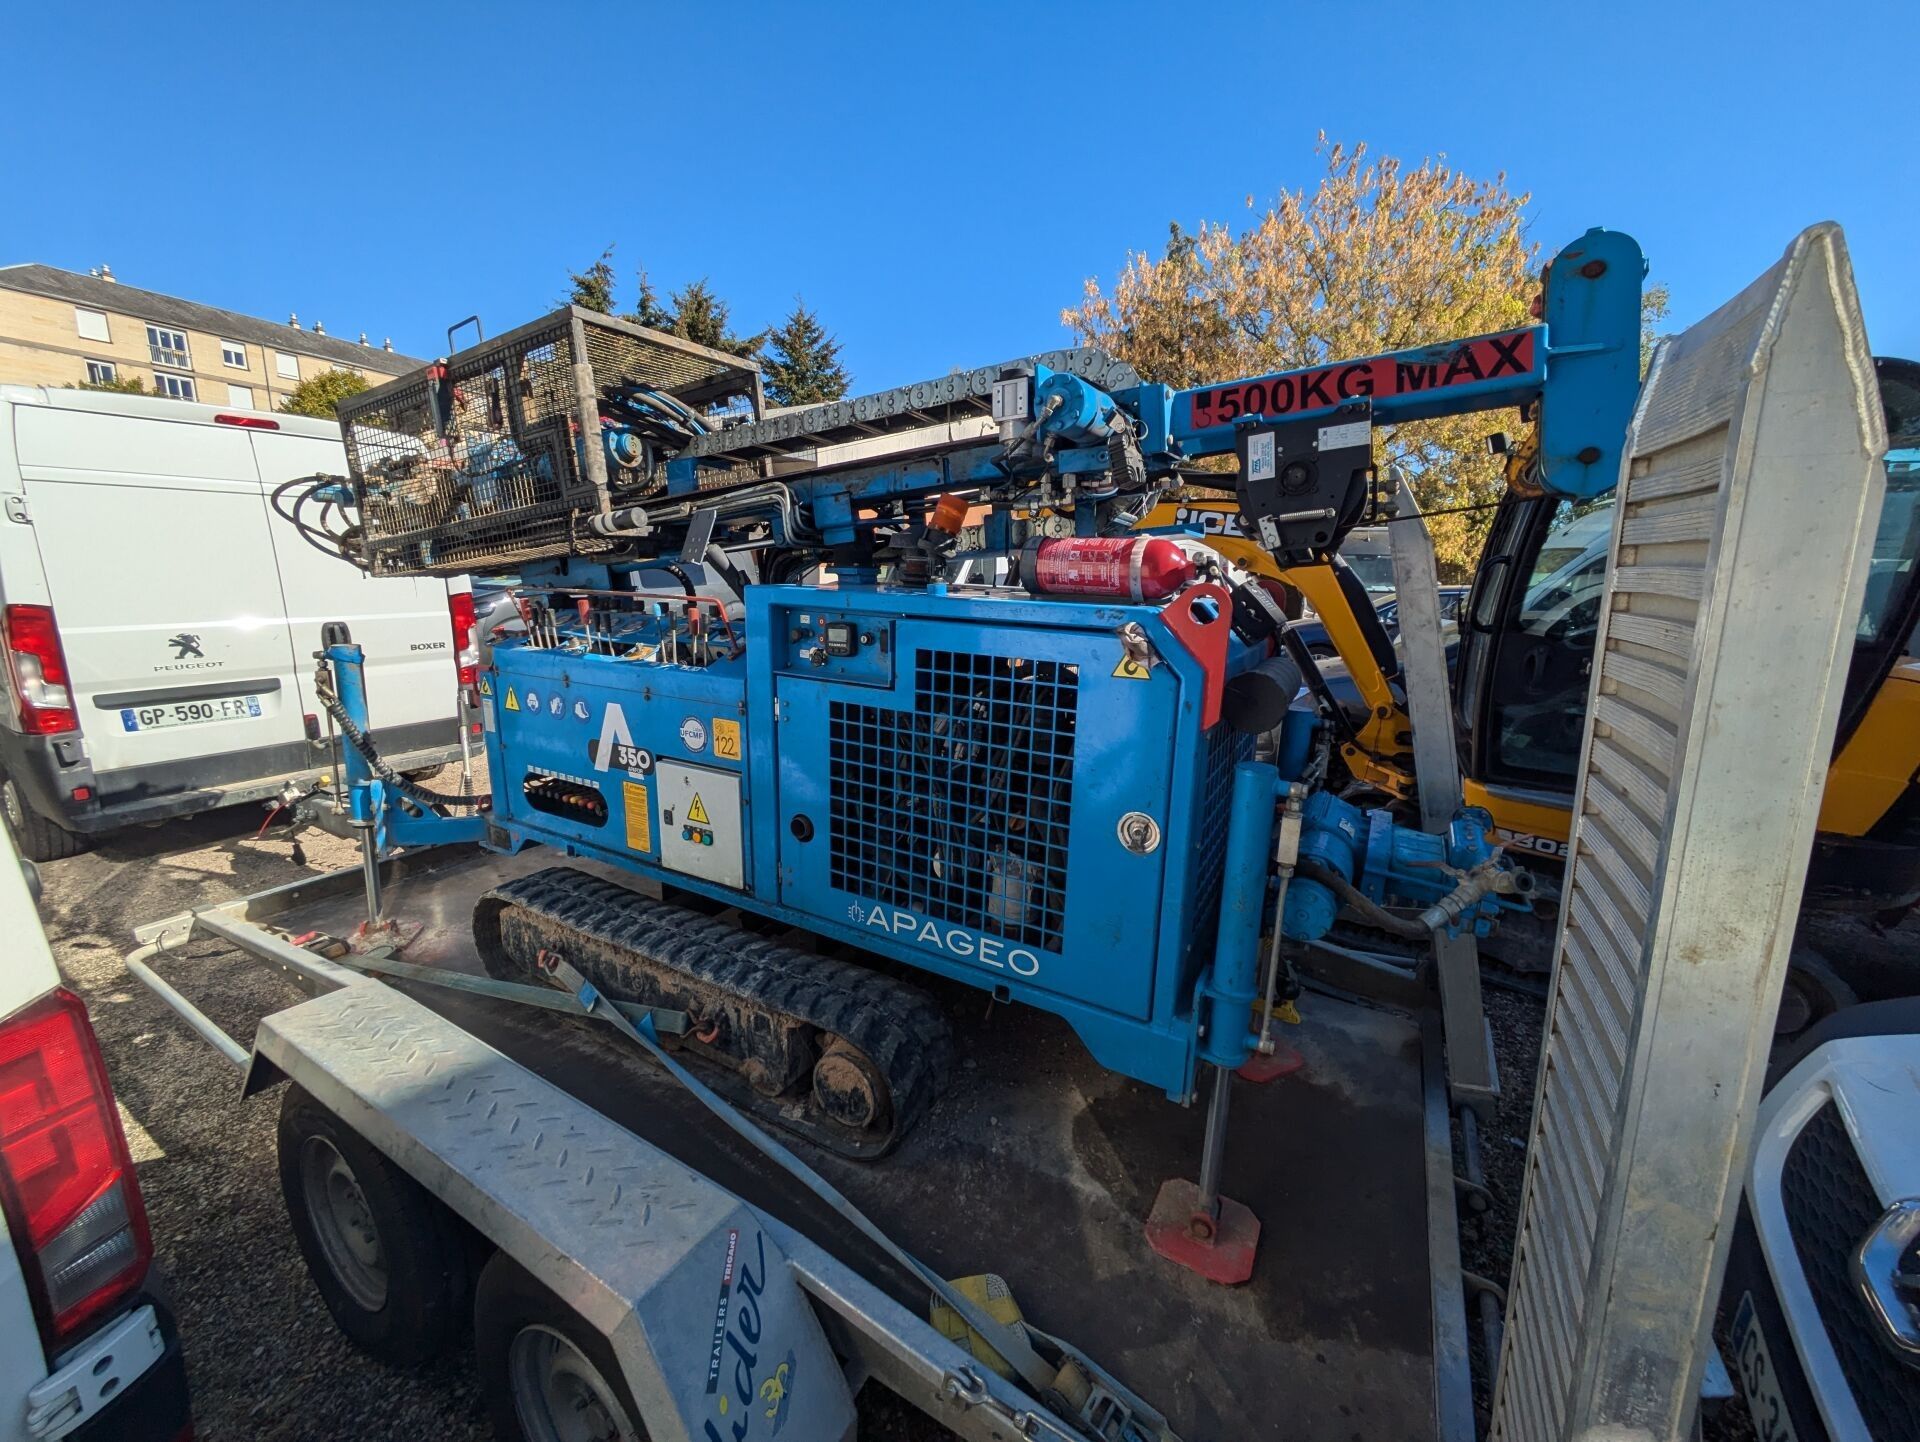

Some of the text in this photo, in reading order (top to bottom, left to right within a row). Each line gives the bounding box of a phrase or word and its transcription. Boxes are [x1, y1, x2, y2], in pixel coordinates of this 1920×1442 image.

[1216, 333, 1528, 423] 500KG MAX
[410, 642, 446, 651] BOXER
[153, 661, 225, 672] PEUGEOT
[139, 699, 247, 726] GP-590-FR
[617, 745, 651, 769] 350
[714, 735, 735, 757] 122
[866, 905, 1040, 976] APAGEO
[709, 1232, 737, 1381] TRAILERS TRIGANO
